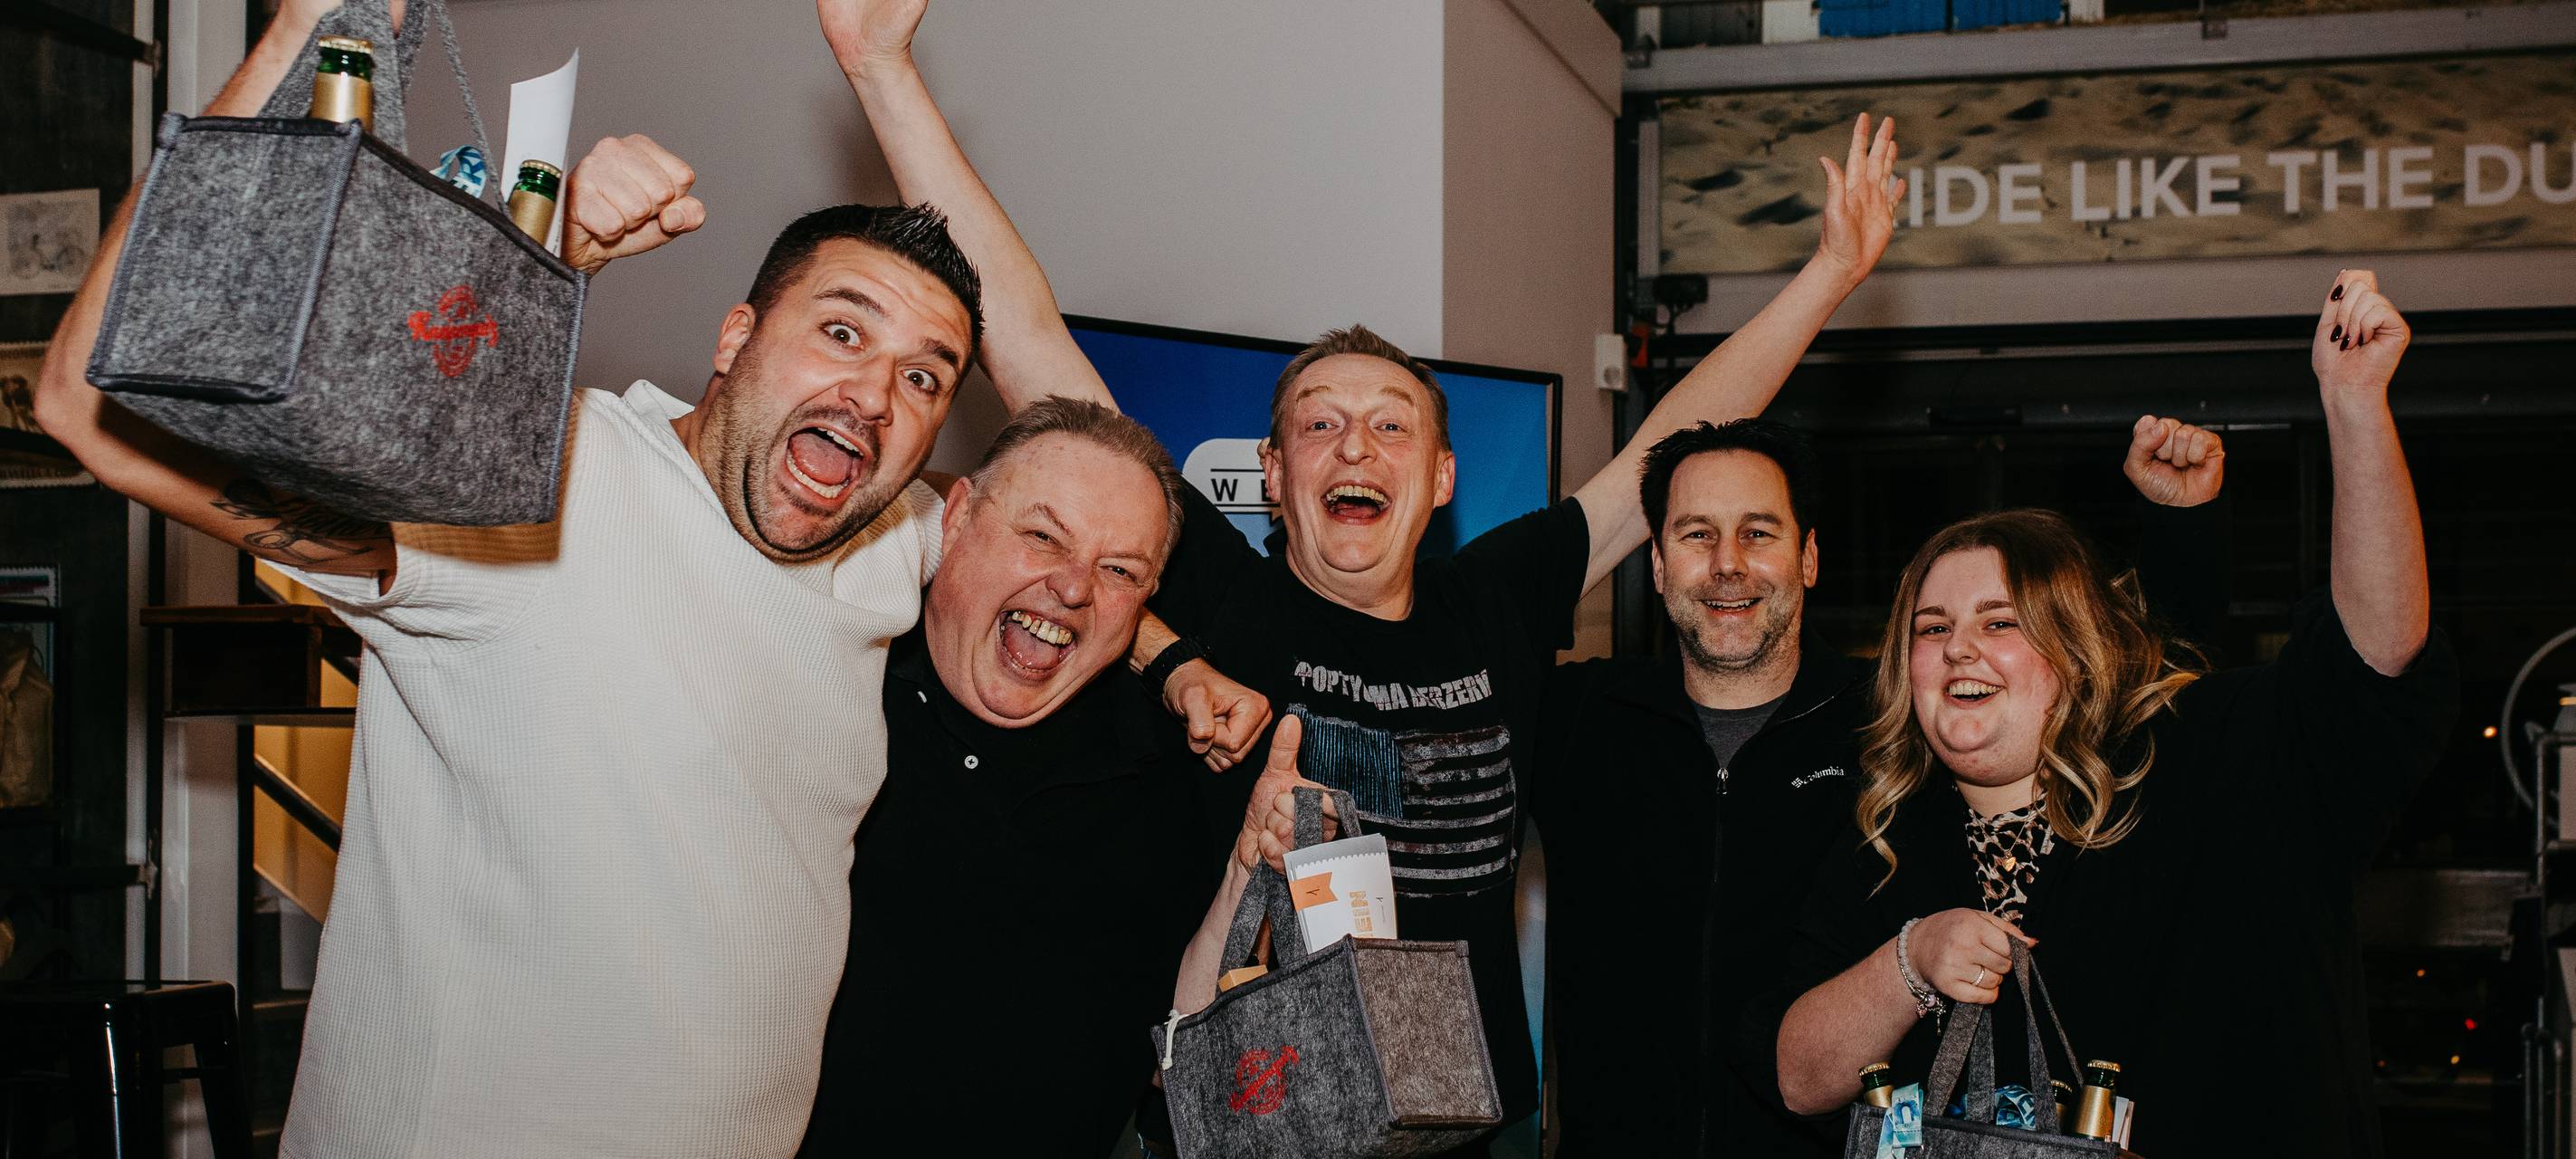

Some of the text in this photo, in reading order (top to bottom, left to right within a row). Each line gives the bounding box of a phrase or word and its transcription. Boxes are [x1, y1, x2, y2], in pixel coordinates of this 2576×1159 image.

[1888, 163, 2043, 226] IDE
[2071, 153, 2241, 221] LIKE
[2266, 146, 2434, 214] THE
[1803, 765, 1845, 785] Columbia
